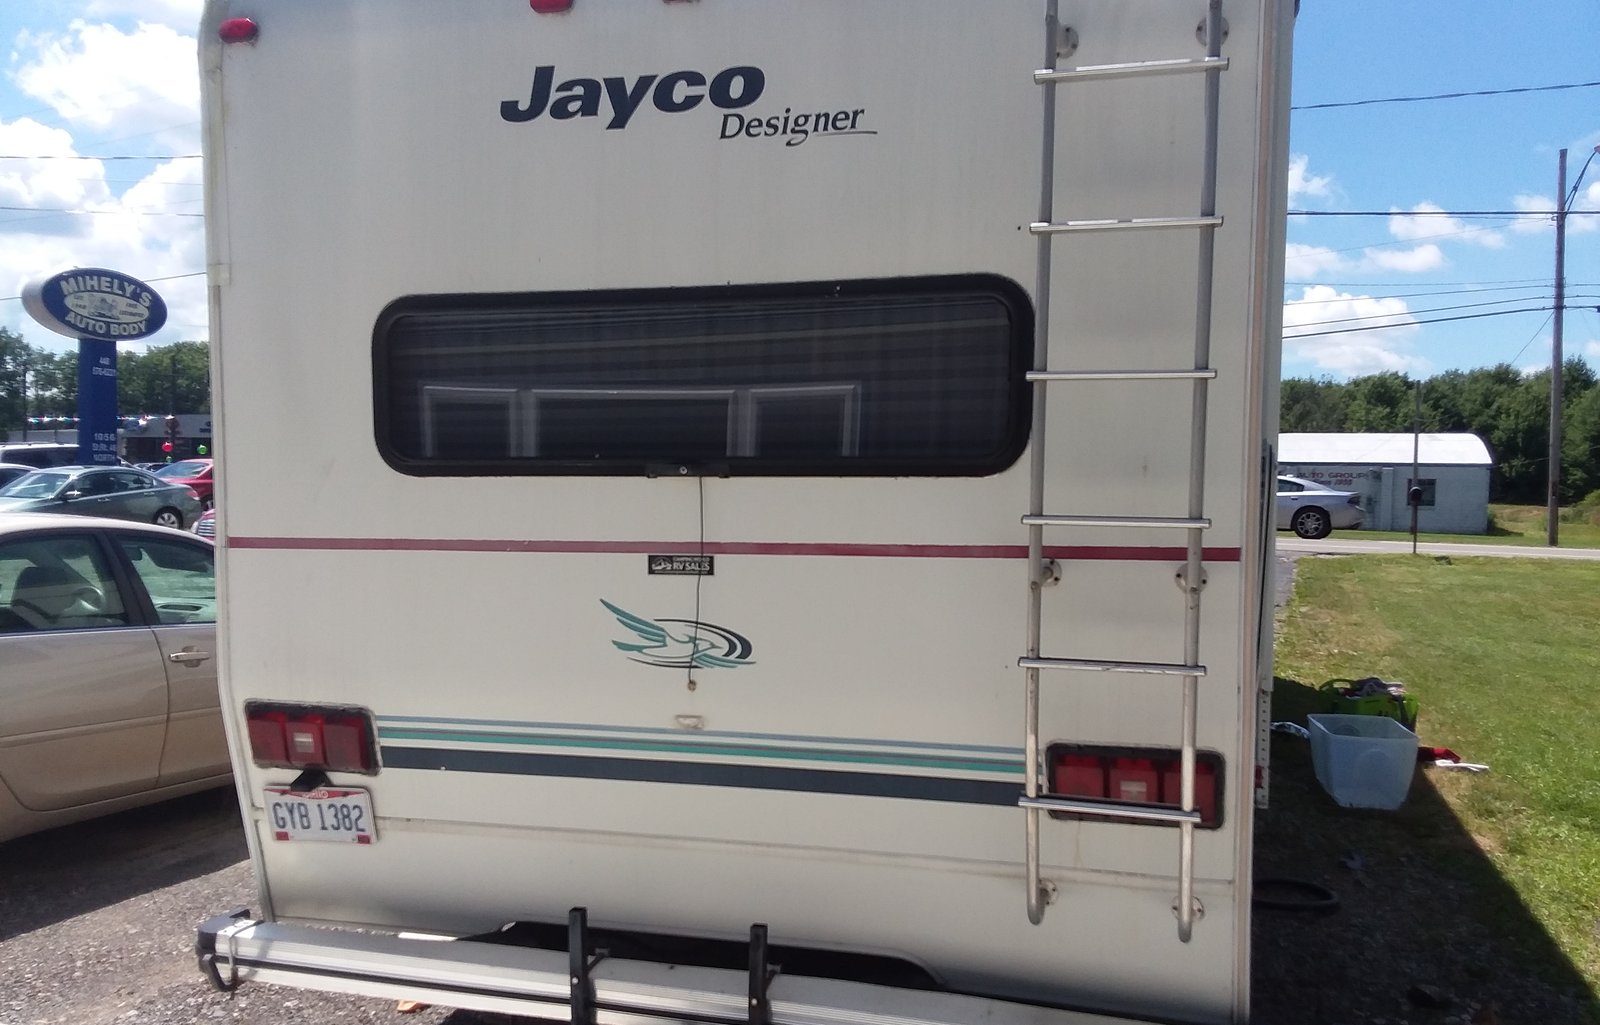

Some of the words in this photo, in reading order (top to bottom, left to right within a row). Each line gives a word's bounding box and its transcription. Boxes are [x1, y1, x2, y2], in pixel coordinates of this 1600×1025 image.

[500, 65, 766, 130] Jayco
[719, 107, 868, 146] Designer
[60, 275, 151, 307] MIHELY'S
[65, 311, 106, 334] AUTO
[109, 320, 147, 335] BODY
[673, 562, 684, 570] RV
[272, 801, 311, 830] GYB
[317, 803, 366, 833] 1382
